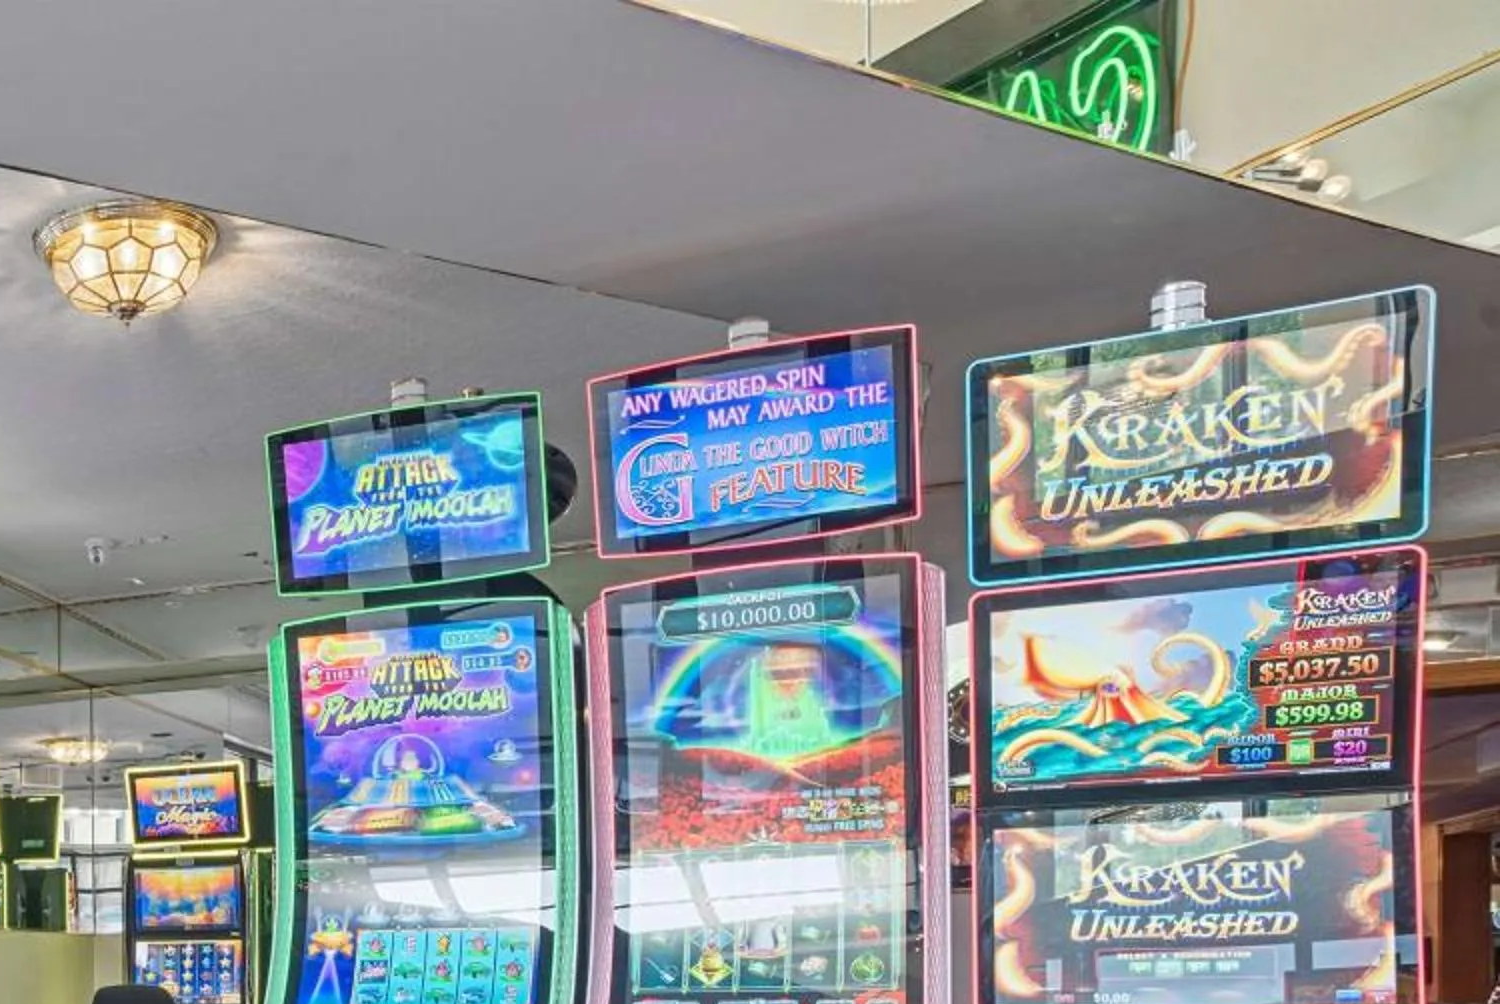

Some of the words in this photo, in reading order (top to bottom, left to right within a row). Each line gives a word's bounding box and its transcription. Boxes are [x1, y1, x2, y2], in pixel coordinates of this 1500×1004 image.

[620, 391, 663, 417] ANY
[670, 373, 767, 410] WAGERED
[776, 364, 825, 394] SPIN
[707, 406, 751, 430] MAY
[758, 391, 834, 423] AWARD
[844, 381, 888, 406] THE
[704, 443, 742, 469] THE
[750, 431, 813, 463] GOOD
[821, 420, 889, 450] WITCH
[1040, 378, 1344, 473] KRAKEN
[356, 456, 458, 493] ATTACK
[708, 460, 867, 512] FEATURE
[1040, 453, 1333, 522] UNLEASHED
[297, 503, 400, 550] PLANET
[408, 486, 512, 524] MOOLAH
[1294, 585, 1396, 615] KRAKEN
[372, 656, 460, 685] ATTACK
[316, 694, 410, 733] PLANET
[414, 687, 509, 715] MOOLAH
[1275, 701, 1364, 727] $599.98
[1229, 746, 1273, 763] $100
[1333, 740, 1368, 756] $20
[1066, 843, 1305, 910] KRAKEN
[1069, 910, 1299, 942] UNLEASHED
